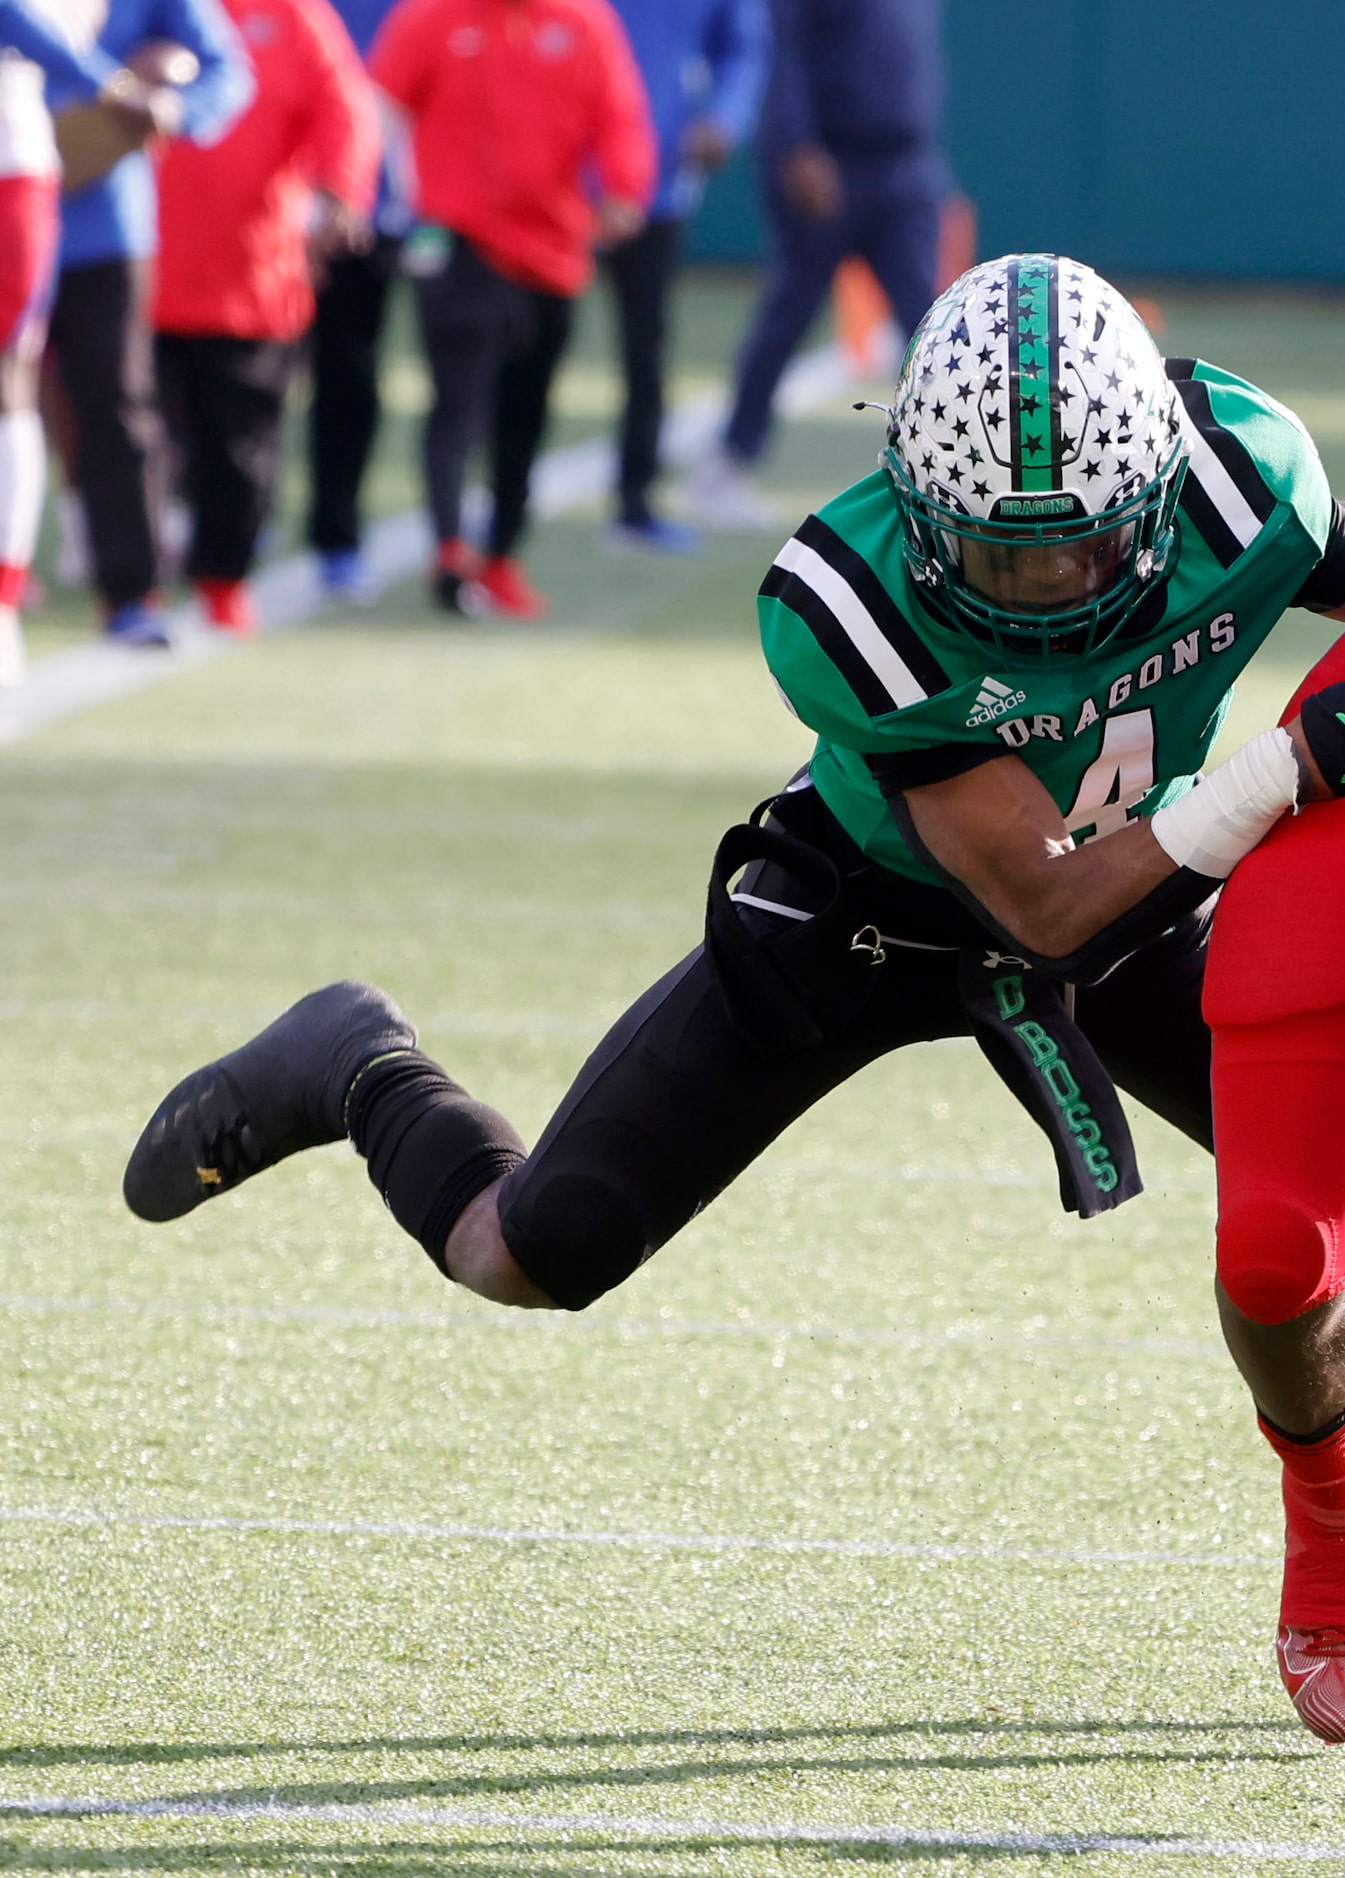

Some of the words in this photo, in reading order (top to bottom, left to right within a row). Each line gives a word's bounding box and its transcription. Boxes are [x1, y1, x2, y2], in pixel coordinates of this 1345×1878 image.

[1000, 496, 1074, 516] DRAGONS
[965, 688, 1027, 728] adidas
[996, 611, 1236, 749] DRAGONS
[1062, 707, 1155, 846] 4
